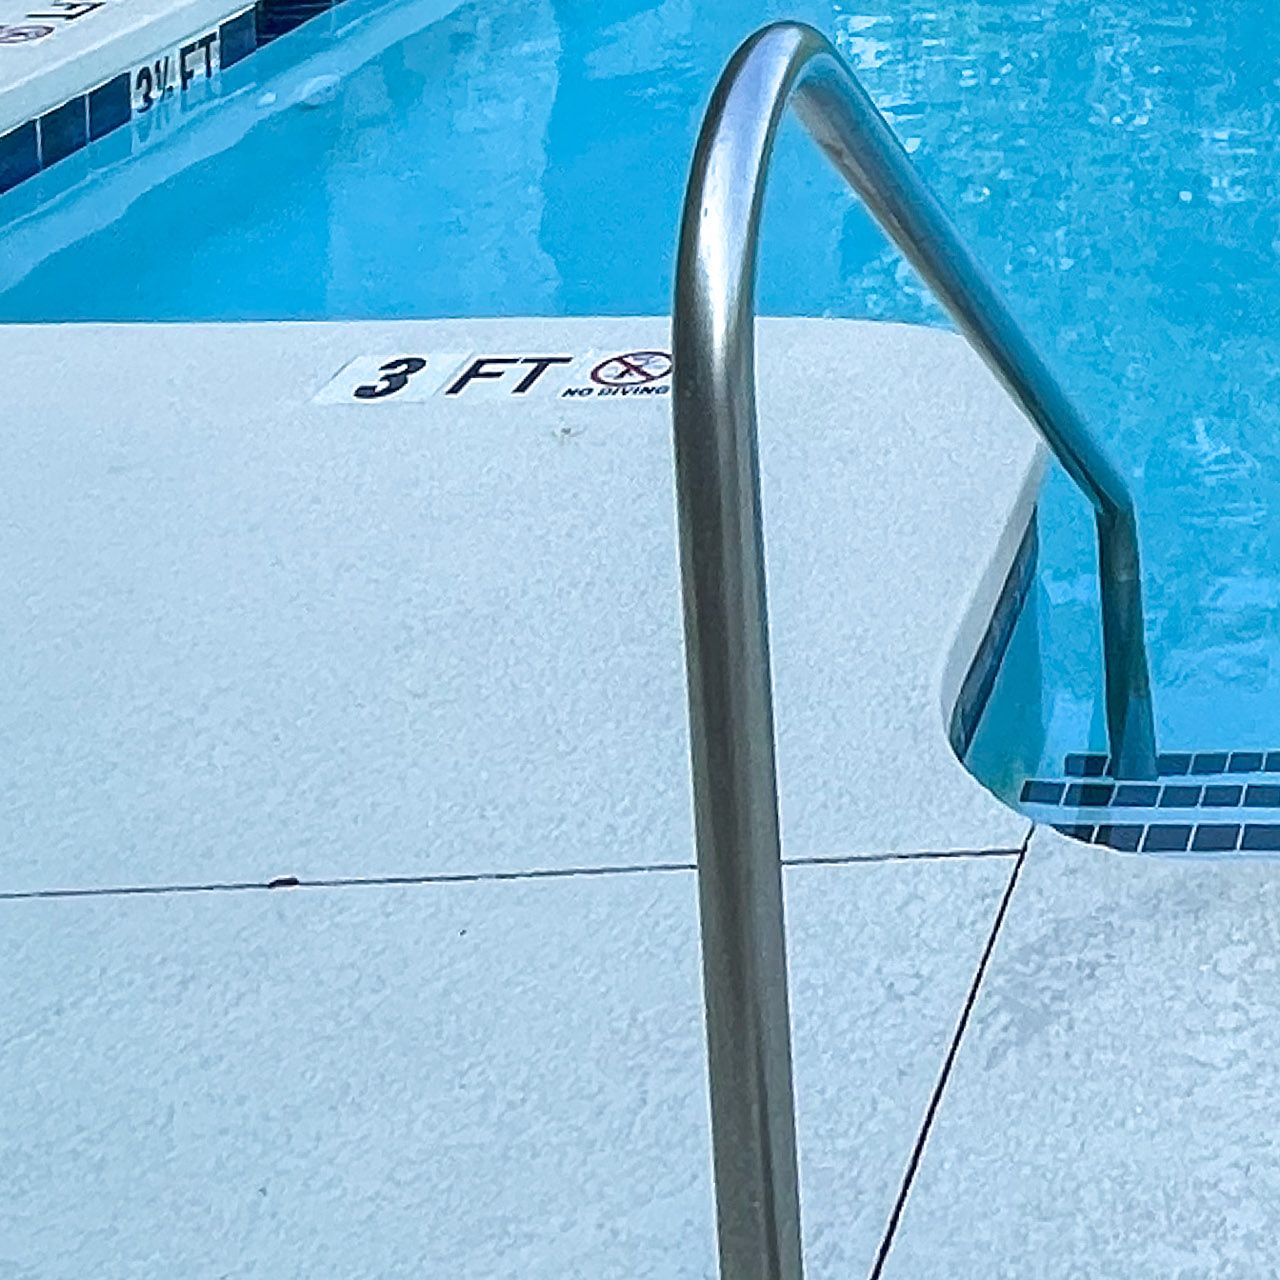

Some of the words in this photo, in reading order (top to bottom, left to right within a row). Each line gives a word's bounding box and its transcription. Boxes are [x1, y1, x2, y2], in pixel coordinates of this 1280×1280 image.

[178, 31, 218, 91] FT
[353, 357, 428, 399] 3
[445, 356, 575, 396] FT
[561, 388, 594, 398] NO
[597, 385, 671, 397] DIVING
